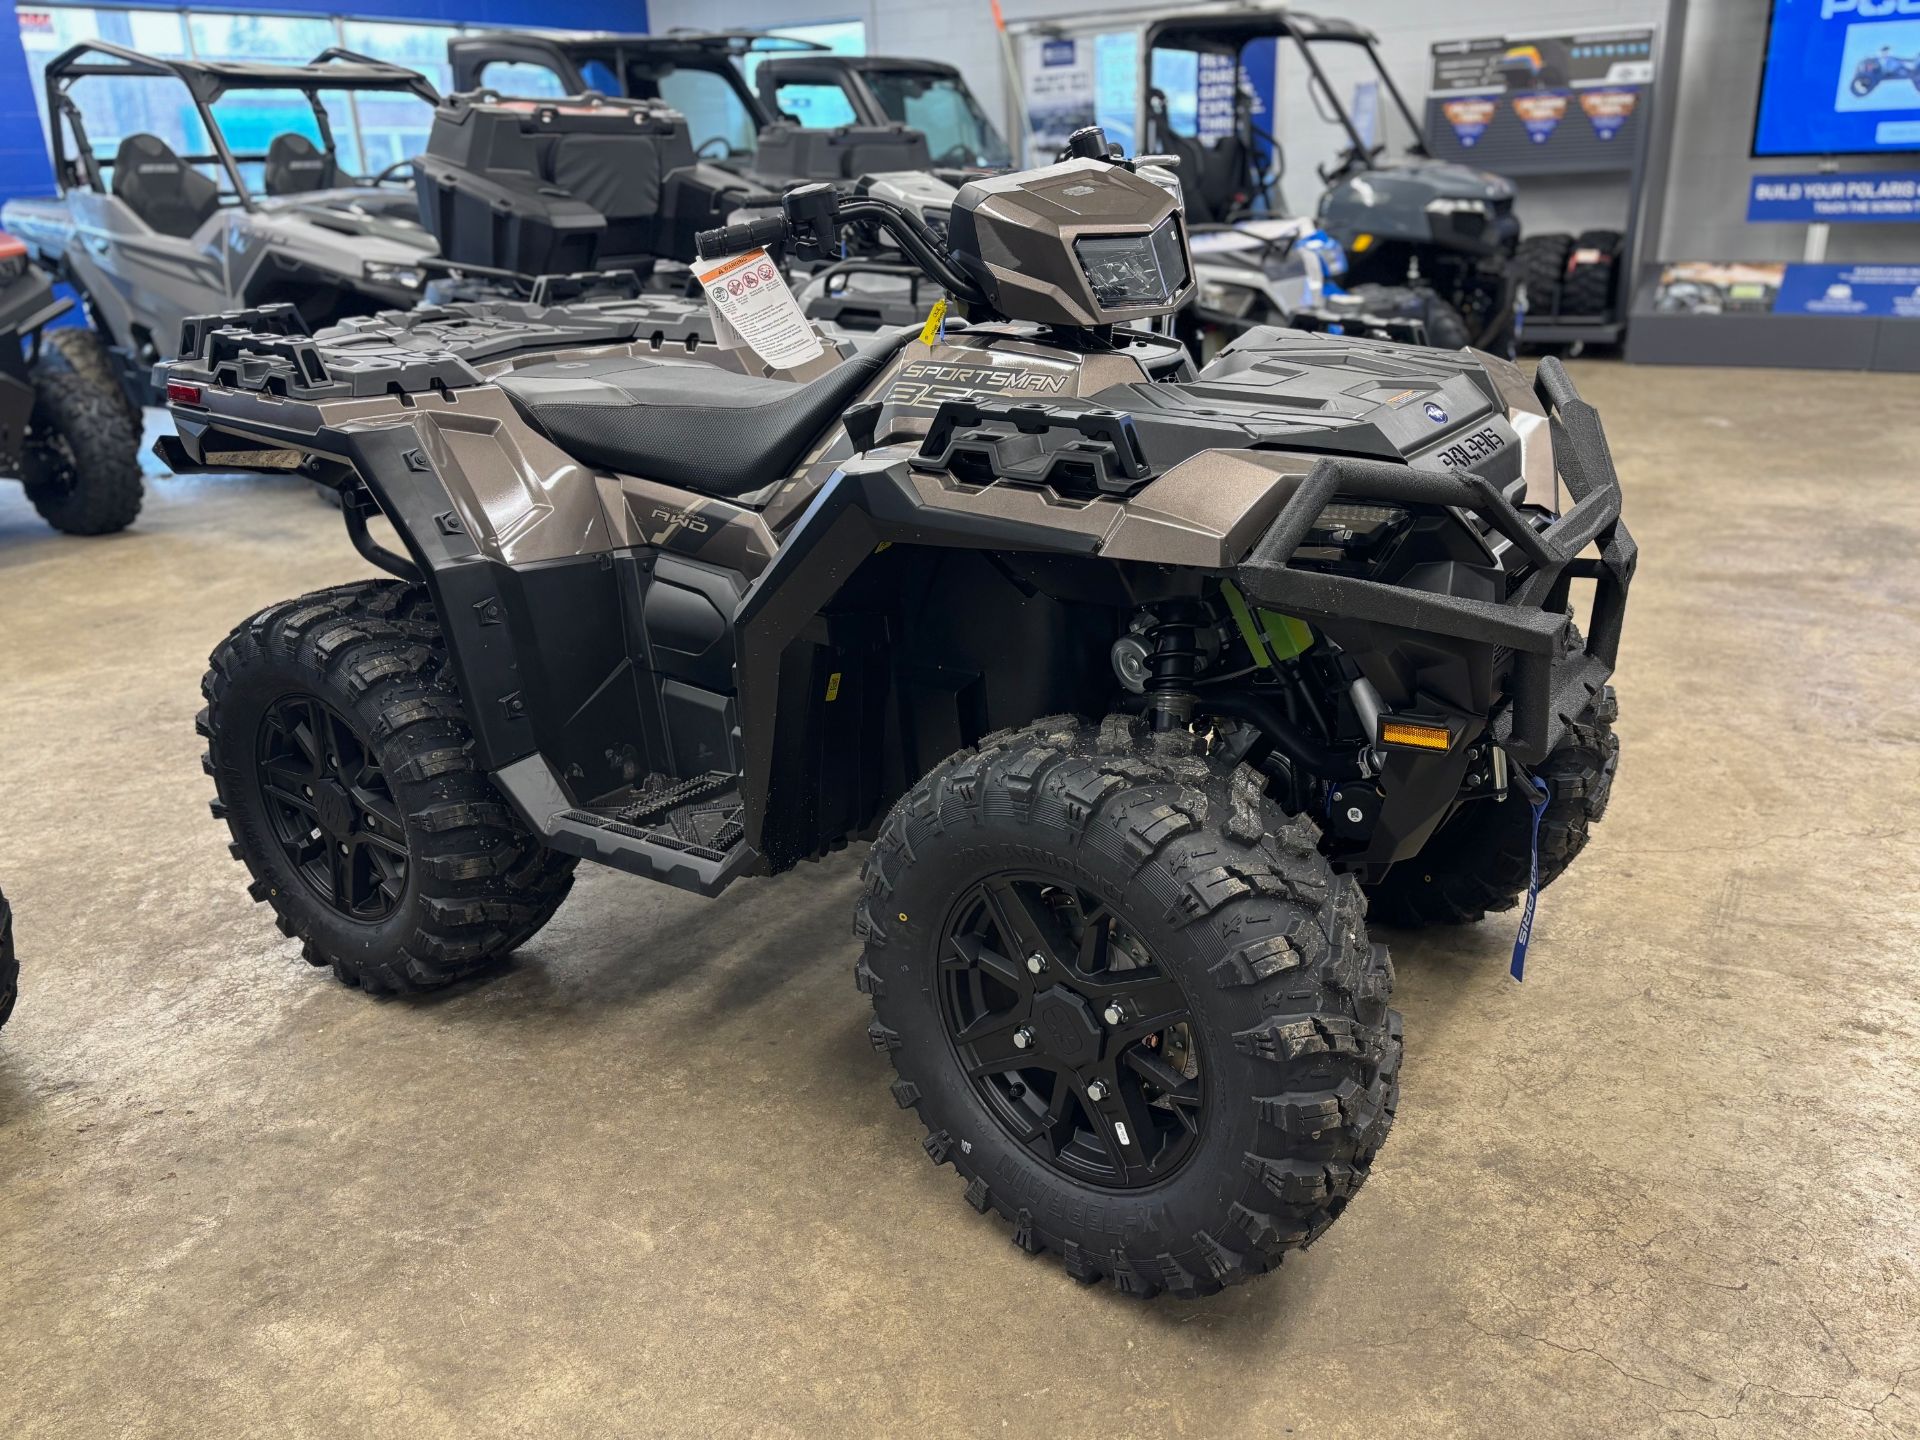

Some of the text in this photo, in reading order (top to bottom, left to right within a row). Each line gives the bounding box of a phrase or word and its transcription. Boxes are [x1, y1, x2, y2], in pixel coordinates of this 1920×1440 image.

[1755, 183, 1802, 200] BUILD
[1804, 182, 1845, 199] YOUR
[1846, 180, 1916, 199] POLARIS
[723, 257, 748, 272] WARNING
[902, 365, 1070, 393] SPORTSMAN
[882, 381, 1013, 409] 85
[1438, 427, 1505, 468] POLARIS
[651, 509, 709, 533] AWD
[1518, 848, 1537, 946] POLARIS
[993, 1154, 1160, 1236] X-TERRAIN
